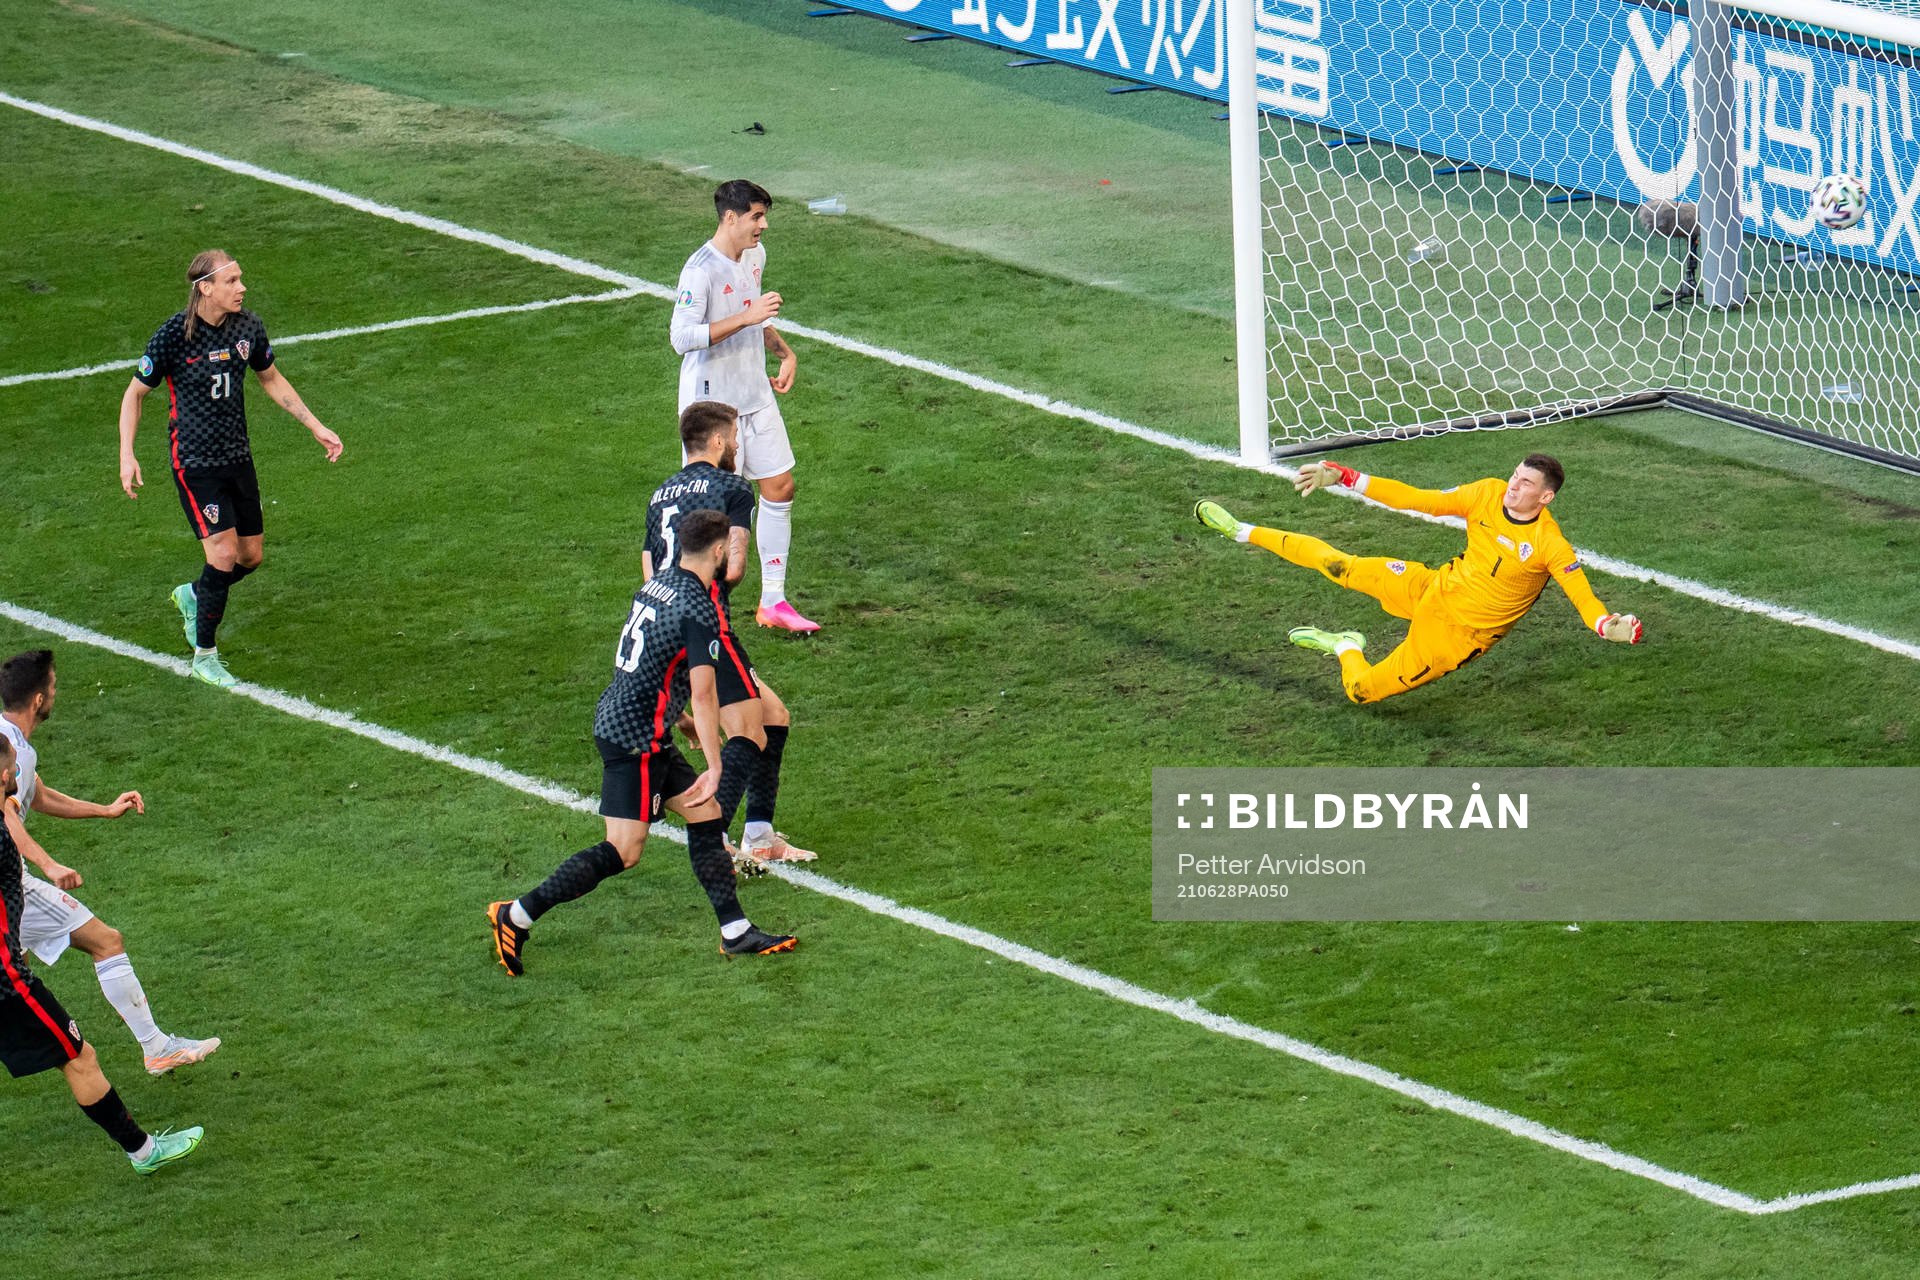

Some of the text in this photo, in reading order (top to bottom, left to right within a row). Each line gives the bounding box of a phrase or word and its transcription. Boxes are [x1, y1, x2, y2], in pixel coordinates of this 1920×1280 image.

[211, 372, 230, 399] 21
[658, 504, 681, 571] 5
[1491, 556, 1503, 577] 1
